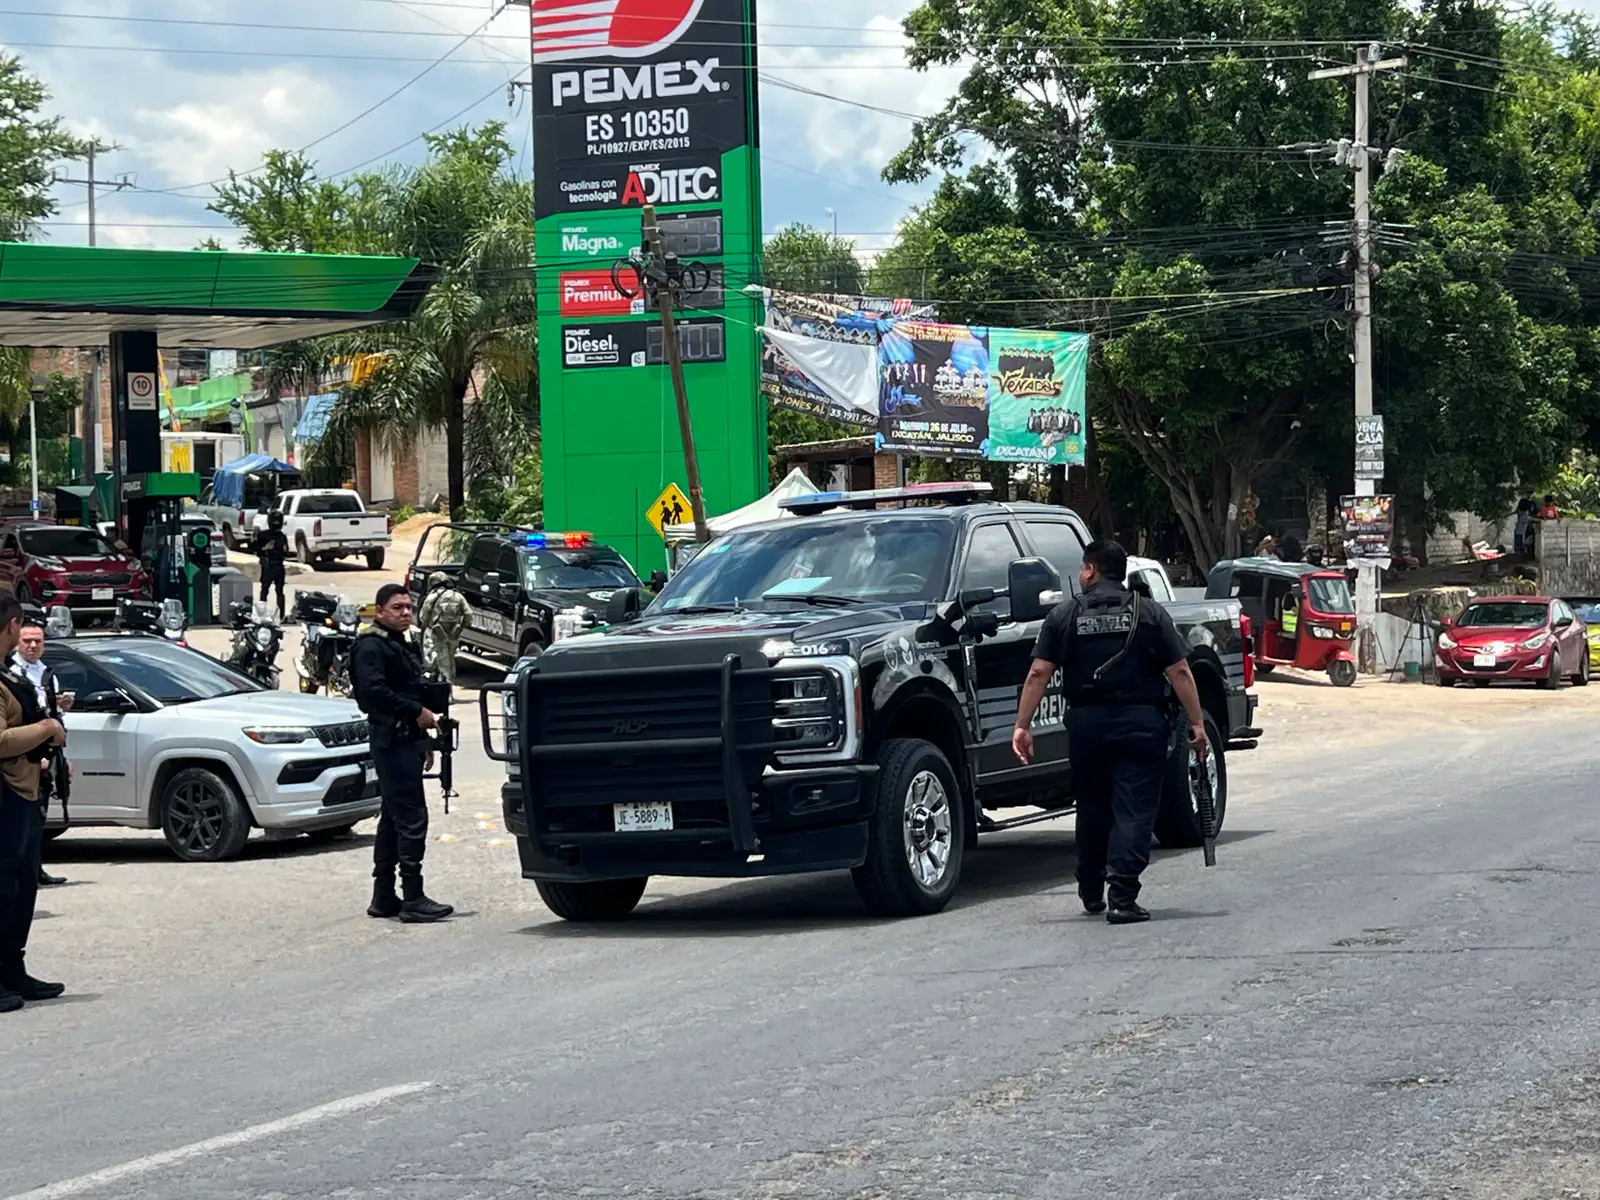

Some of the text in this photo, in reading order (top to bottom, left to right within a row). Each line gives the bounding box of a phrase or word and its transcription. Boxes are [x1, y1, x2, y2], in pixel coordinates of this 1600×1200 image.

[551, 57, 720, 107] PEMEX
[586, 107, 689, 141] ES 10350
[587, 137, 690, 156] PL/10927/EXP/ES/2015
[628, 163, 660, 172] PEMEX
[560, 179, 617, 191] Gasolinas con
[562, 235, 617, 255] Magna
[565, 334, 613, 352] Diesel
[136, 380, 147, 390] 10
[930, 422, 940, 432] 26
[1355, 421, 1384, 432] VENTA
[936, 433, 974, 443] JALISCO
[1356, 432, 1384, 443] CASA
[995, 446, 1048, 459] IXCATÁN
[617, 808, 671, 825] JE-5889-A
